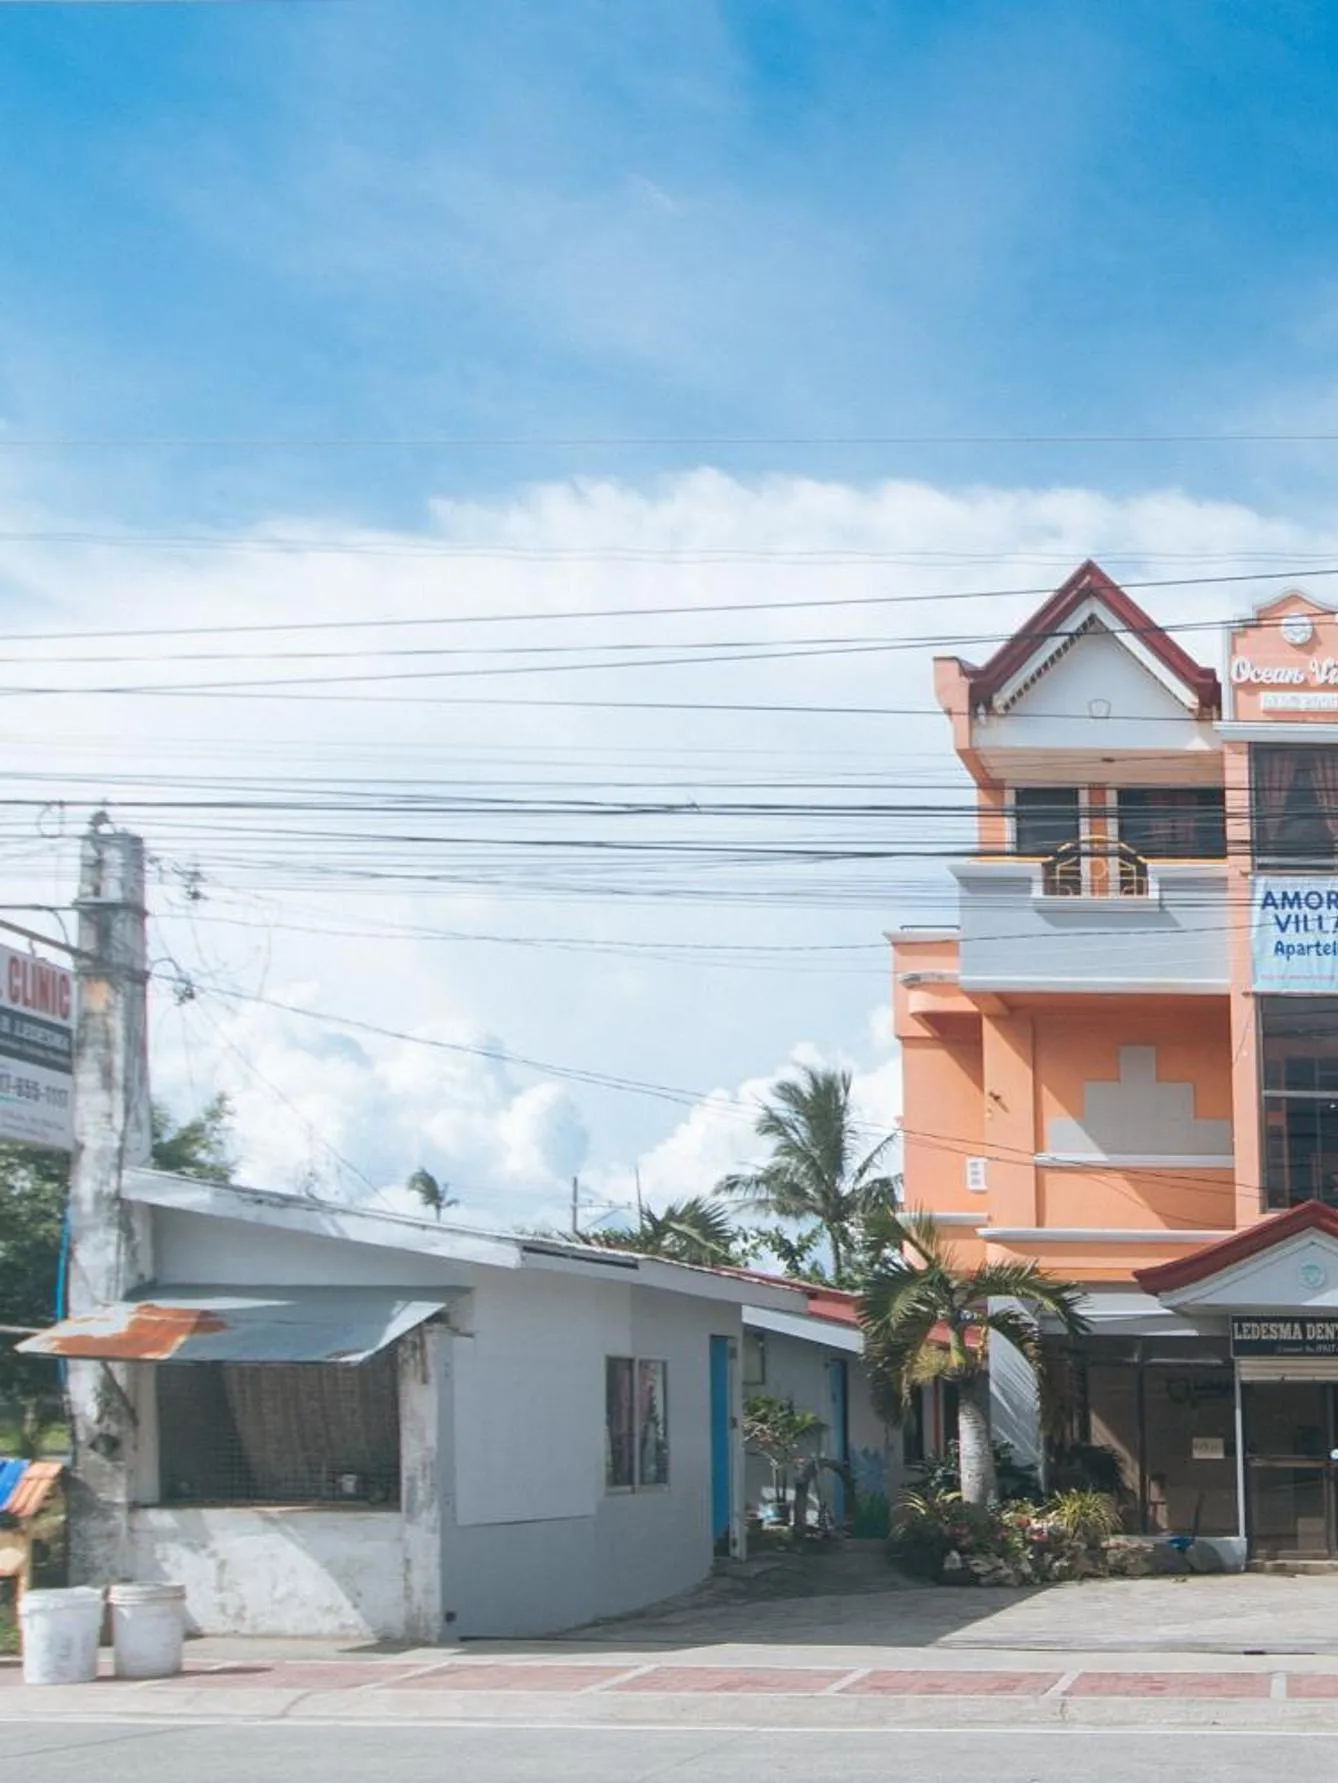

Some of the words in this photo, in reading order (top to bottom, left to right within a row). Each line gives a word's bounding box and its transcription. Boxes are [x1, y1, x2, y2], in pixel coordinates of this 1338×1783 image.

[1231, 656, 1305, 684] Ocean
[9, 955, 71, 1020] CLINIC
[1233, 1322, 1303, 1341] LEDESMA
